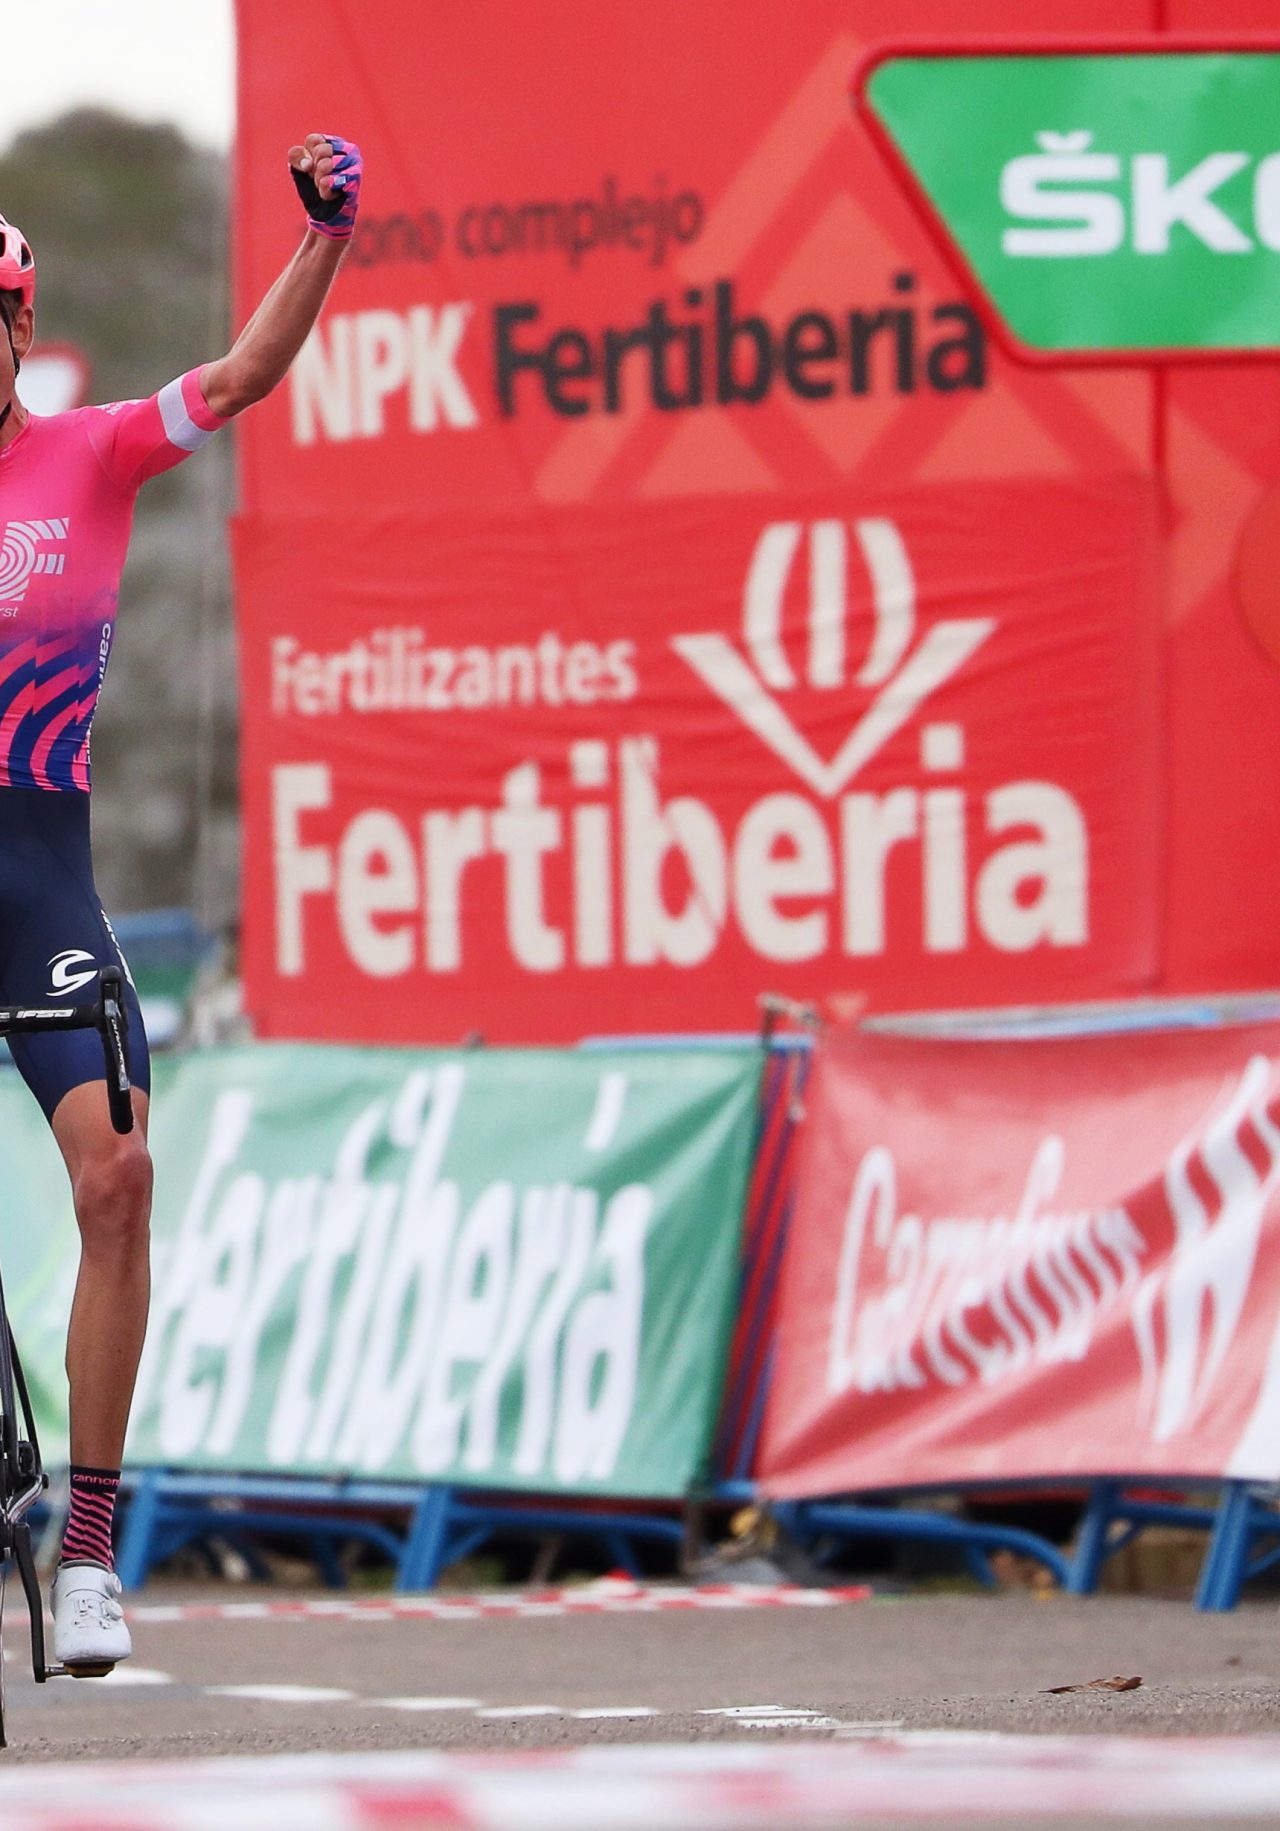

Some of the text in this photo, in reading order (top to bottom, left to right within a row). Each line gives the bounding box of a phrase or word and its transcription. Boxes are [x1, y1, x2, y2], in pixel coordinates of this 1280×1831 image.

[456, 175, 706, 270] complejo
[1002, 130, 1280, 257] ŠK
[290, 274, 986, 447] NPK Fertiberia
[271, 628, 637, 717] Fertilizantes
[270, 724, 1090, 978] Fertiberia
